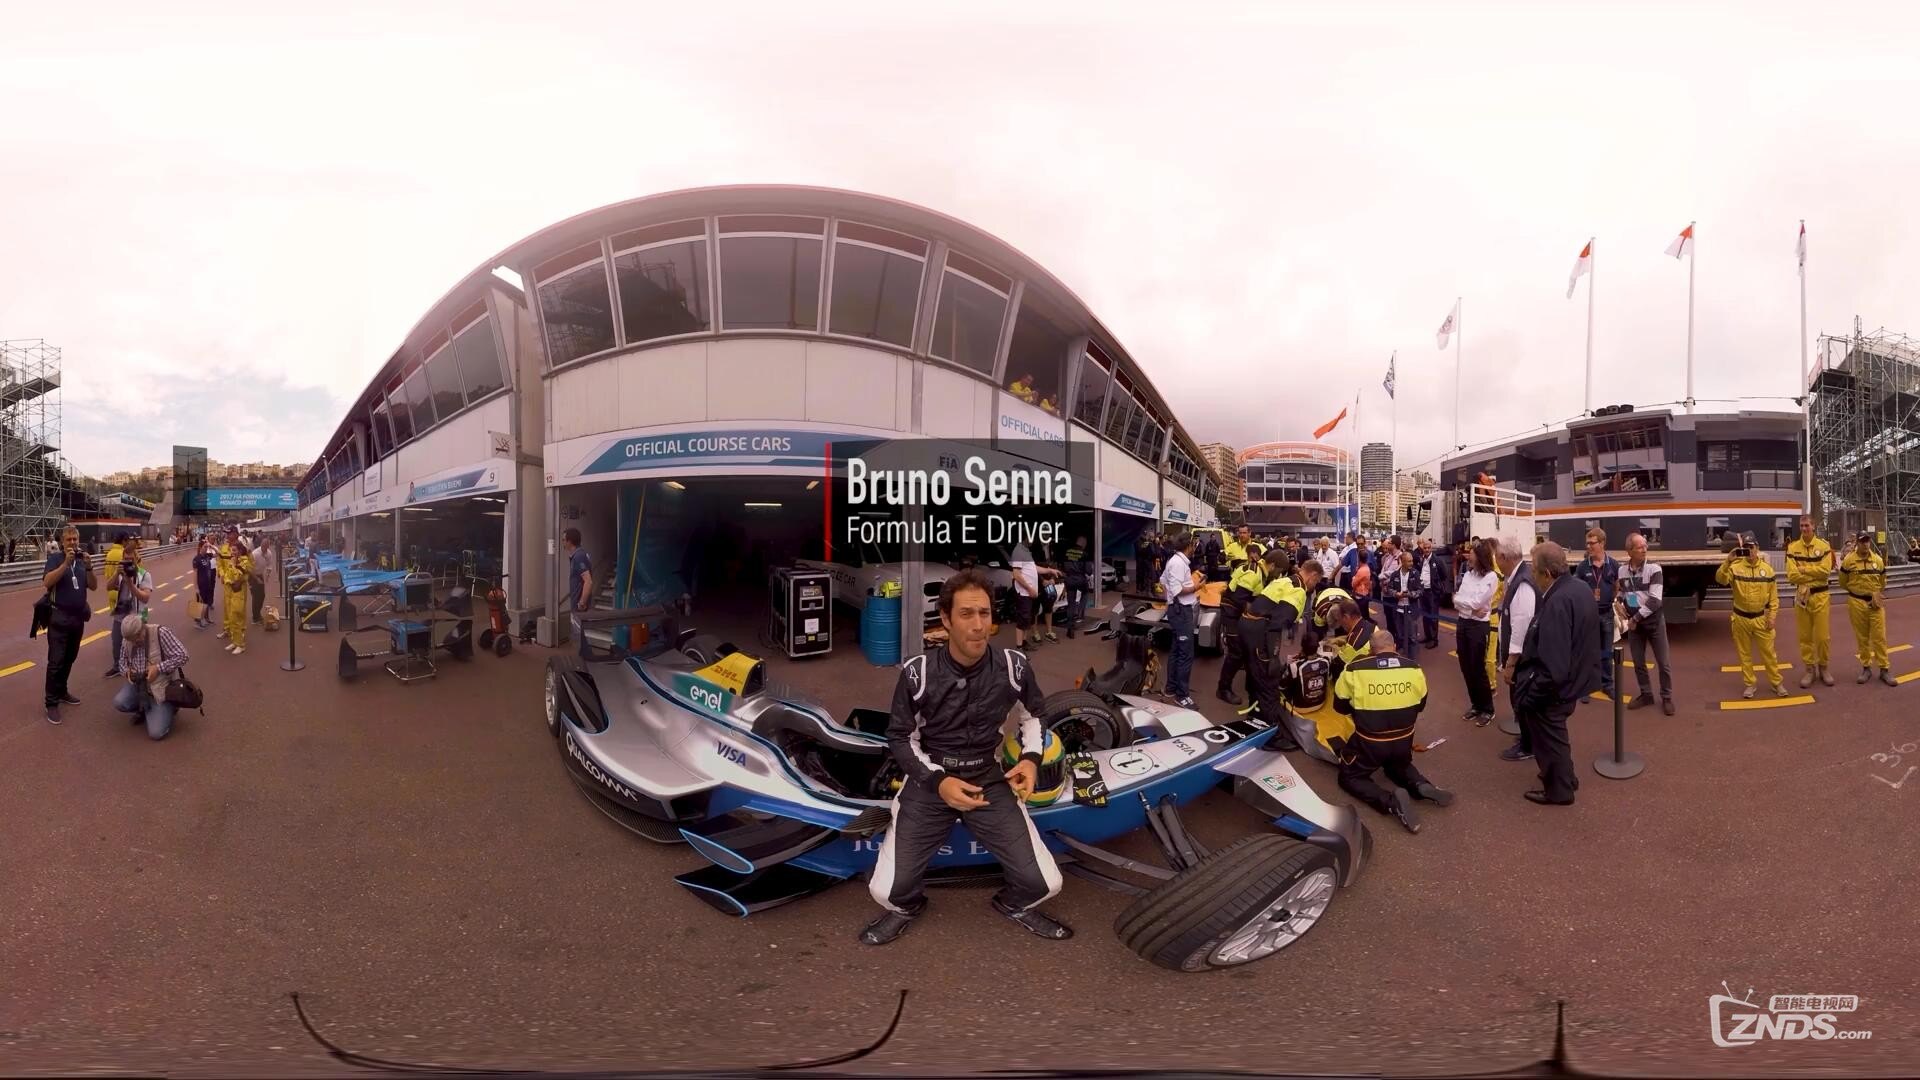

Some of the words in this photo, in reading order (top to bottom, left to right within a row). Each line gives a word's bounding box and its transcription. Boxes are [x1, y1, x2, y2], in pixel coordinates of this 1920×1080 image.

[1001, 415, 1042, 439] OFFICIAL
[625, 440, 684, 457] OFFICIAL
[688, 437, 747, 452] COURSE
[751, 437, 791, 451] CARS
[489, 472, 495, 483] 9
[712, 665, 738, 681] DHL
[690, 684, 723, 712] enel
[1368, 682, 1412, 696] DOCTOR
[716, 742, 747, 767] VISA
